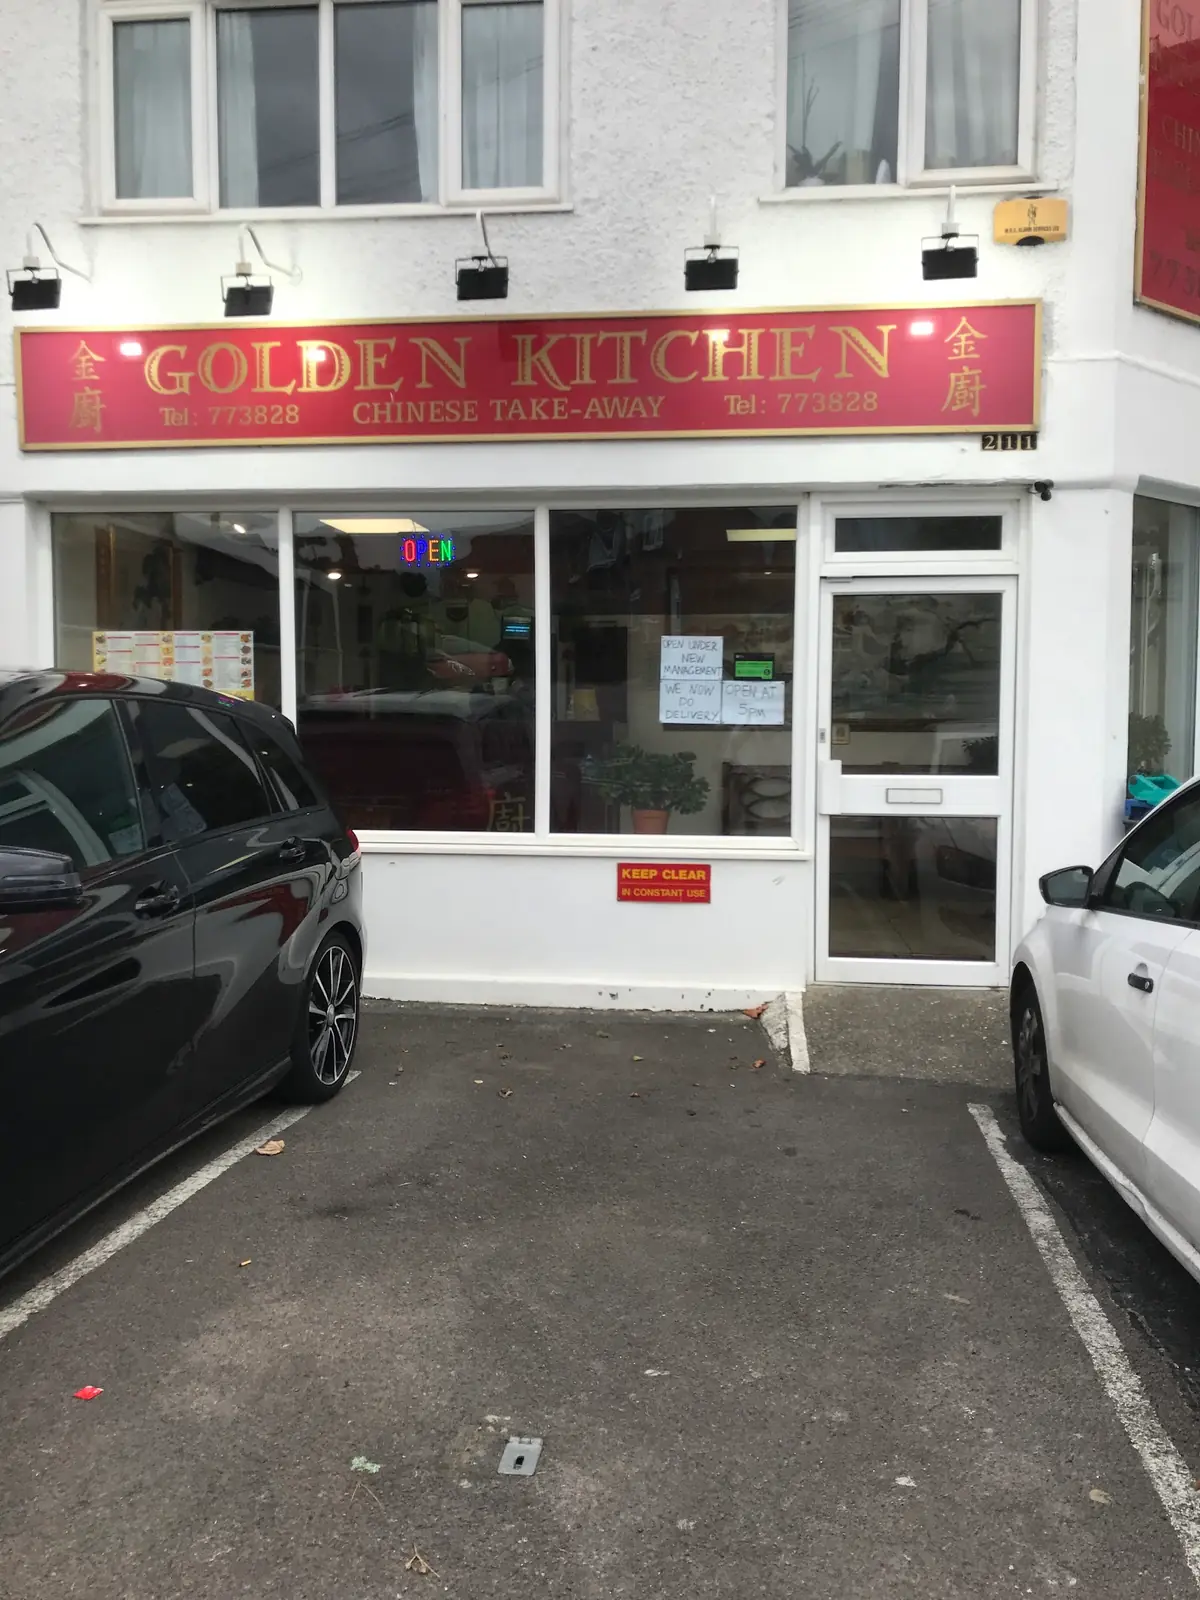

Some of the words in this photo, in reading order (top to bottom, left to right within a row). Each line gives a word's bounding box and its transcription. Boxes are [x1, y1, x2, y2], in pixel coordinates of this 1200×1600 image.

[144, 337, 472, 396] GOLDEN
[511, 324, 897, 391] KITCHEN
[353, 400, 479, 425] CHINESE
[489, 395, 665, 422] TAKE-AWAY
[724, 394, 766, 416] Tel:
[777, 391, 878, 414] 773828
[208, 404, 300, 425] 773828
[983, 435, 1034, 450] 211
[404, 539, 452, 562] OPEN
[663, 639, 684, 649] OPEN
[688, 640, 718, 652] UNDER
[681, 653, 706, 664] NEW
[664, 665, 723, 676] MANAGEMENT
[665, 683, 681, 694] WE
[689, 685, 715, 696] NOW
[726, 684, 757, 698] OPEN
[761, 685, 777, 700] AT
[679, 697, 694, 707] DO
[665, 709, 720, 721] DELIVERY
[622, 868, 658, 879] KEEP
[662, 869, 706, 880] CLEAR
[621, 887, 631, 896] IN
[633, 888, 684, 897] CONSTANT
[687, 889, 706, 898] USE
